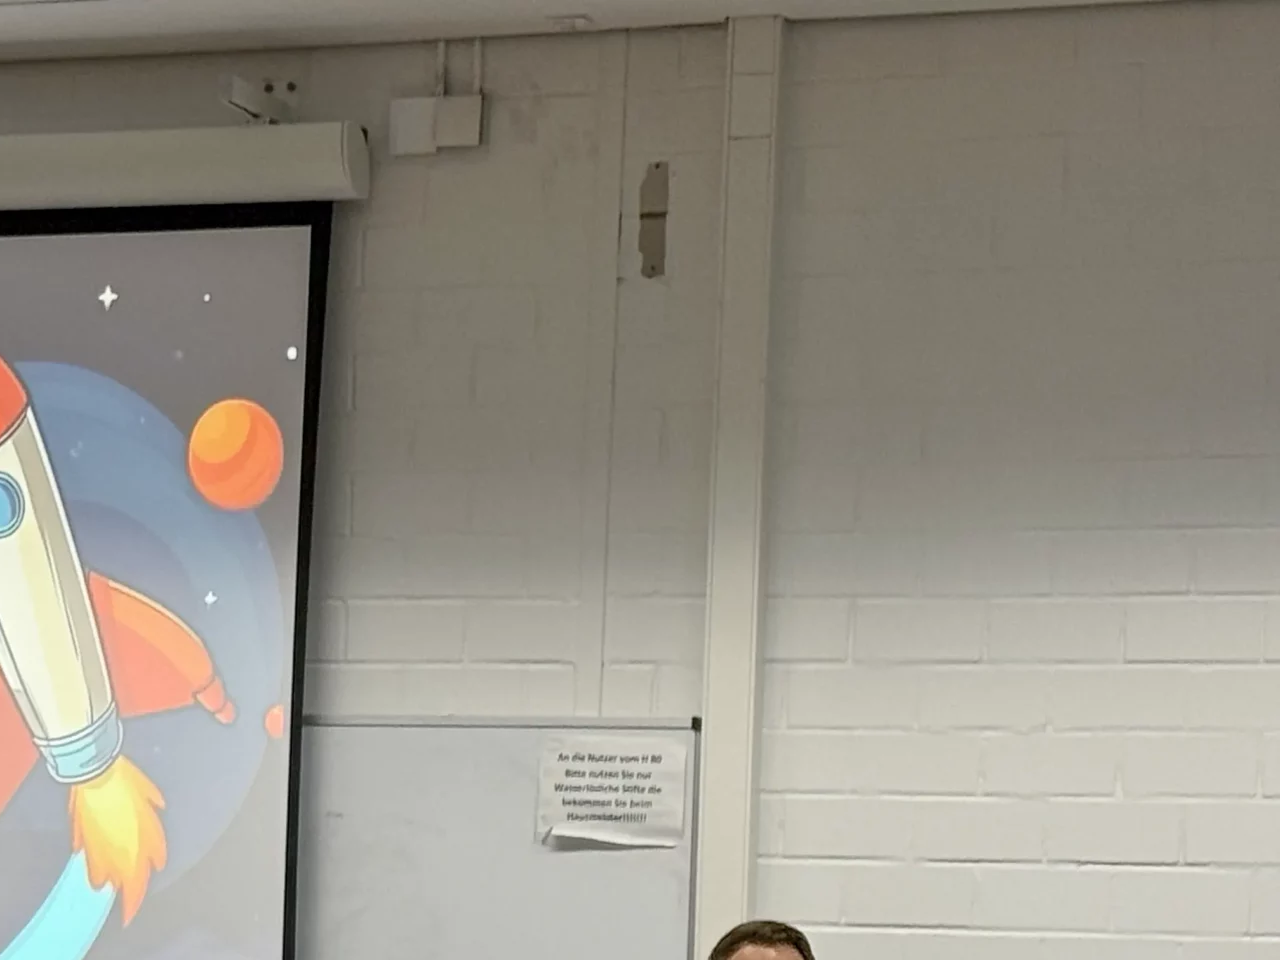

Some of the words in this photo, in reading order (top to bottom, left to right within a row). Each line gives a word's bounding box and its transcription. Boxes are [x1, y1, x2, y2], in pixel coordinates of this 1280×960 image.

[558, 753, 569, 762] An
[572, 752, 585, 762] die
[588, 753, 617, 763] Nutzer
[620, 755, 639, 764] vom
[565, 769, 586, 778] Bitte
[589, 769, 619, 779] nutzen
[621, 770, 634, 780] Sie
[636, 772, 651, 780] nur
[648, 785, 662, 794] die
